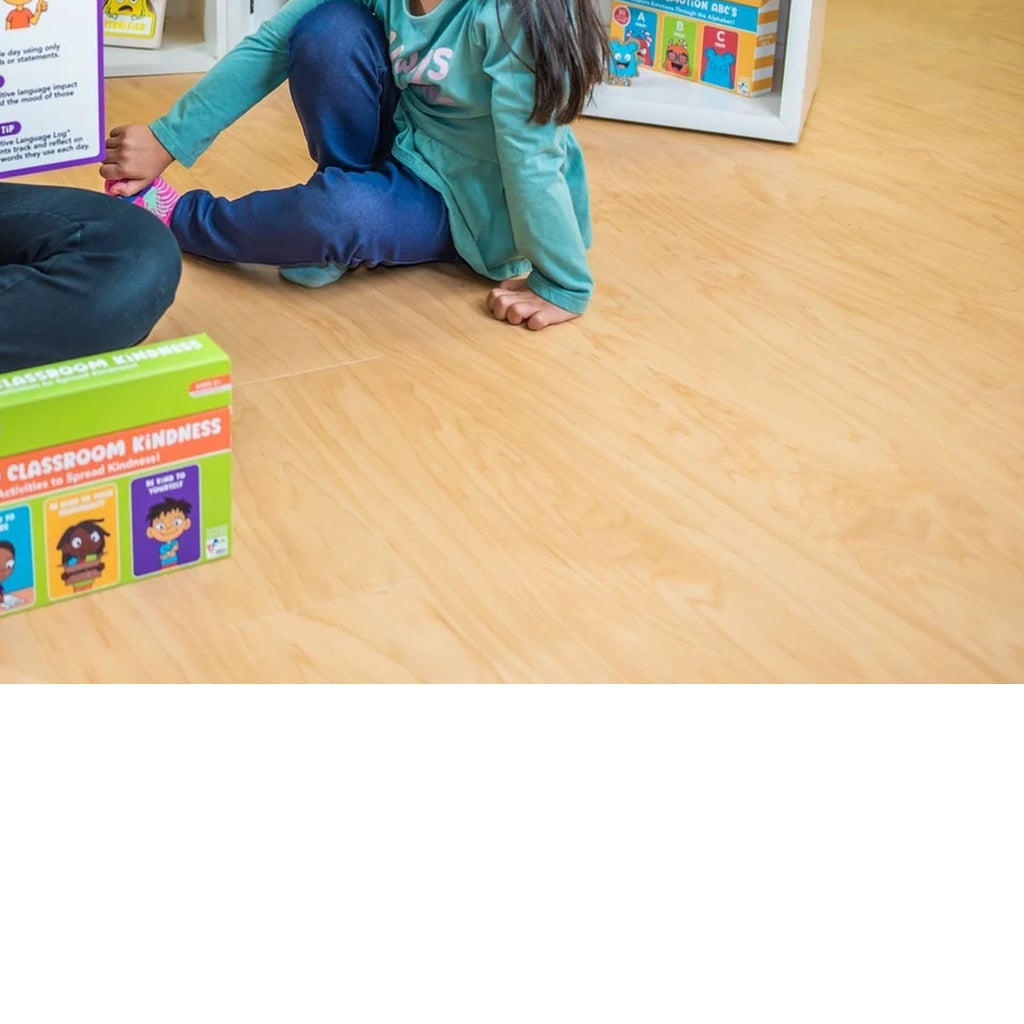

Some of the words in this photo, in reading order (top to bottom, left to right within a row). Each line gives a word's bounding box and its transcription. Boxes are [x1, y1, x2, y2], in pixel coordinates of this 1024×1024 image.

[637, 12, 646, 22] A
[675, 7, 696, 17] Through
[711, 3, 737, 17] ABC'S
[676, 21, 684, 31] B
[716, 30, 725, 42] C
[7, 49, 21, 57] day
[23, 45, 42, 54] using
[45, 43, 60, 52] only
[17, 87, 51, 96] language
[53, 81, 78, 91] impact
[7, 97, 19, 105] the
[21, 94, 43, 103] mood
[44, 92, 52, 100] of
[54, 90, 74, 98] those
[16, 134, 51, 144] Language
[53, 129, 71, 139] Log"
[13, 144, 31, 153] track
[33, 141, 47, 150] and
[49, 137, 72, 147] reflect
[0, 154, 23, 163] words
[24, 149, 41, 159] they
[42, 148, 55, 156] use
[57, 144, 74, 153] each
[6, 439, 126, 482] CLASSROOM
[51, 476, 63, 486] to
[66, 464, 105, 483] Spread
[108, 452, 160, 473] Kindness!
[146, 479, 155, 488] BE
[176, 471, 186, 480] TO
[148, 480, 183, 495] YOURSELF
